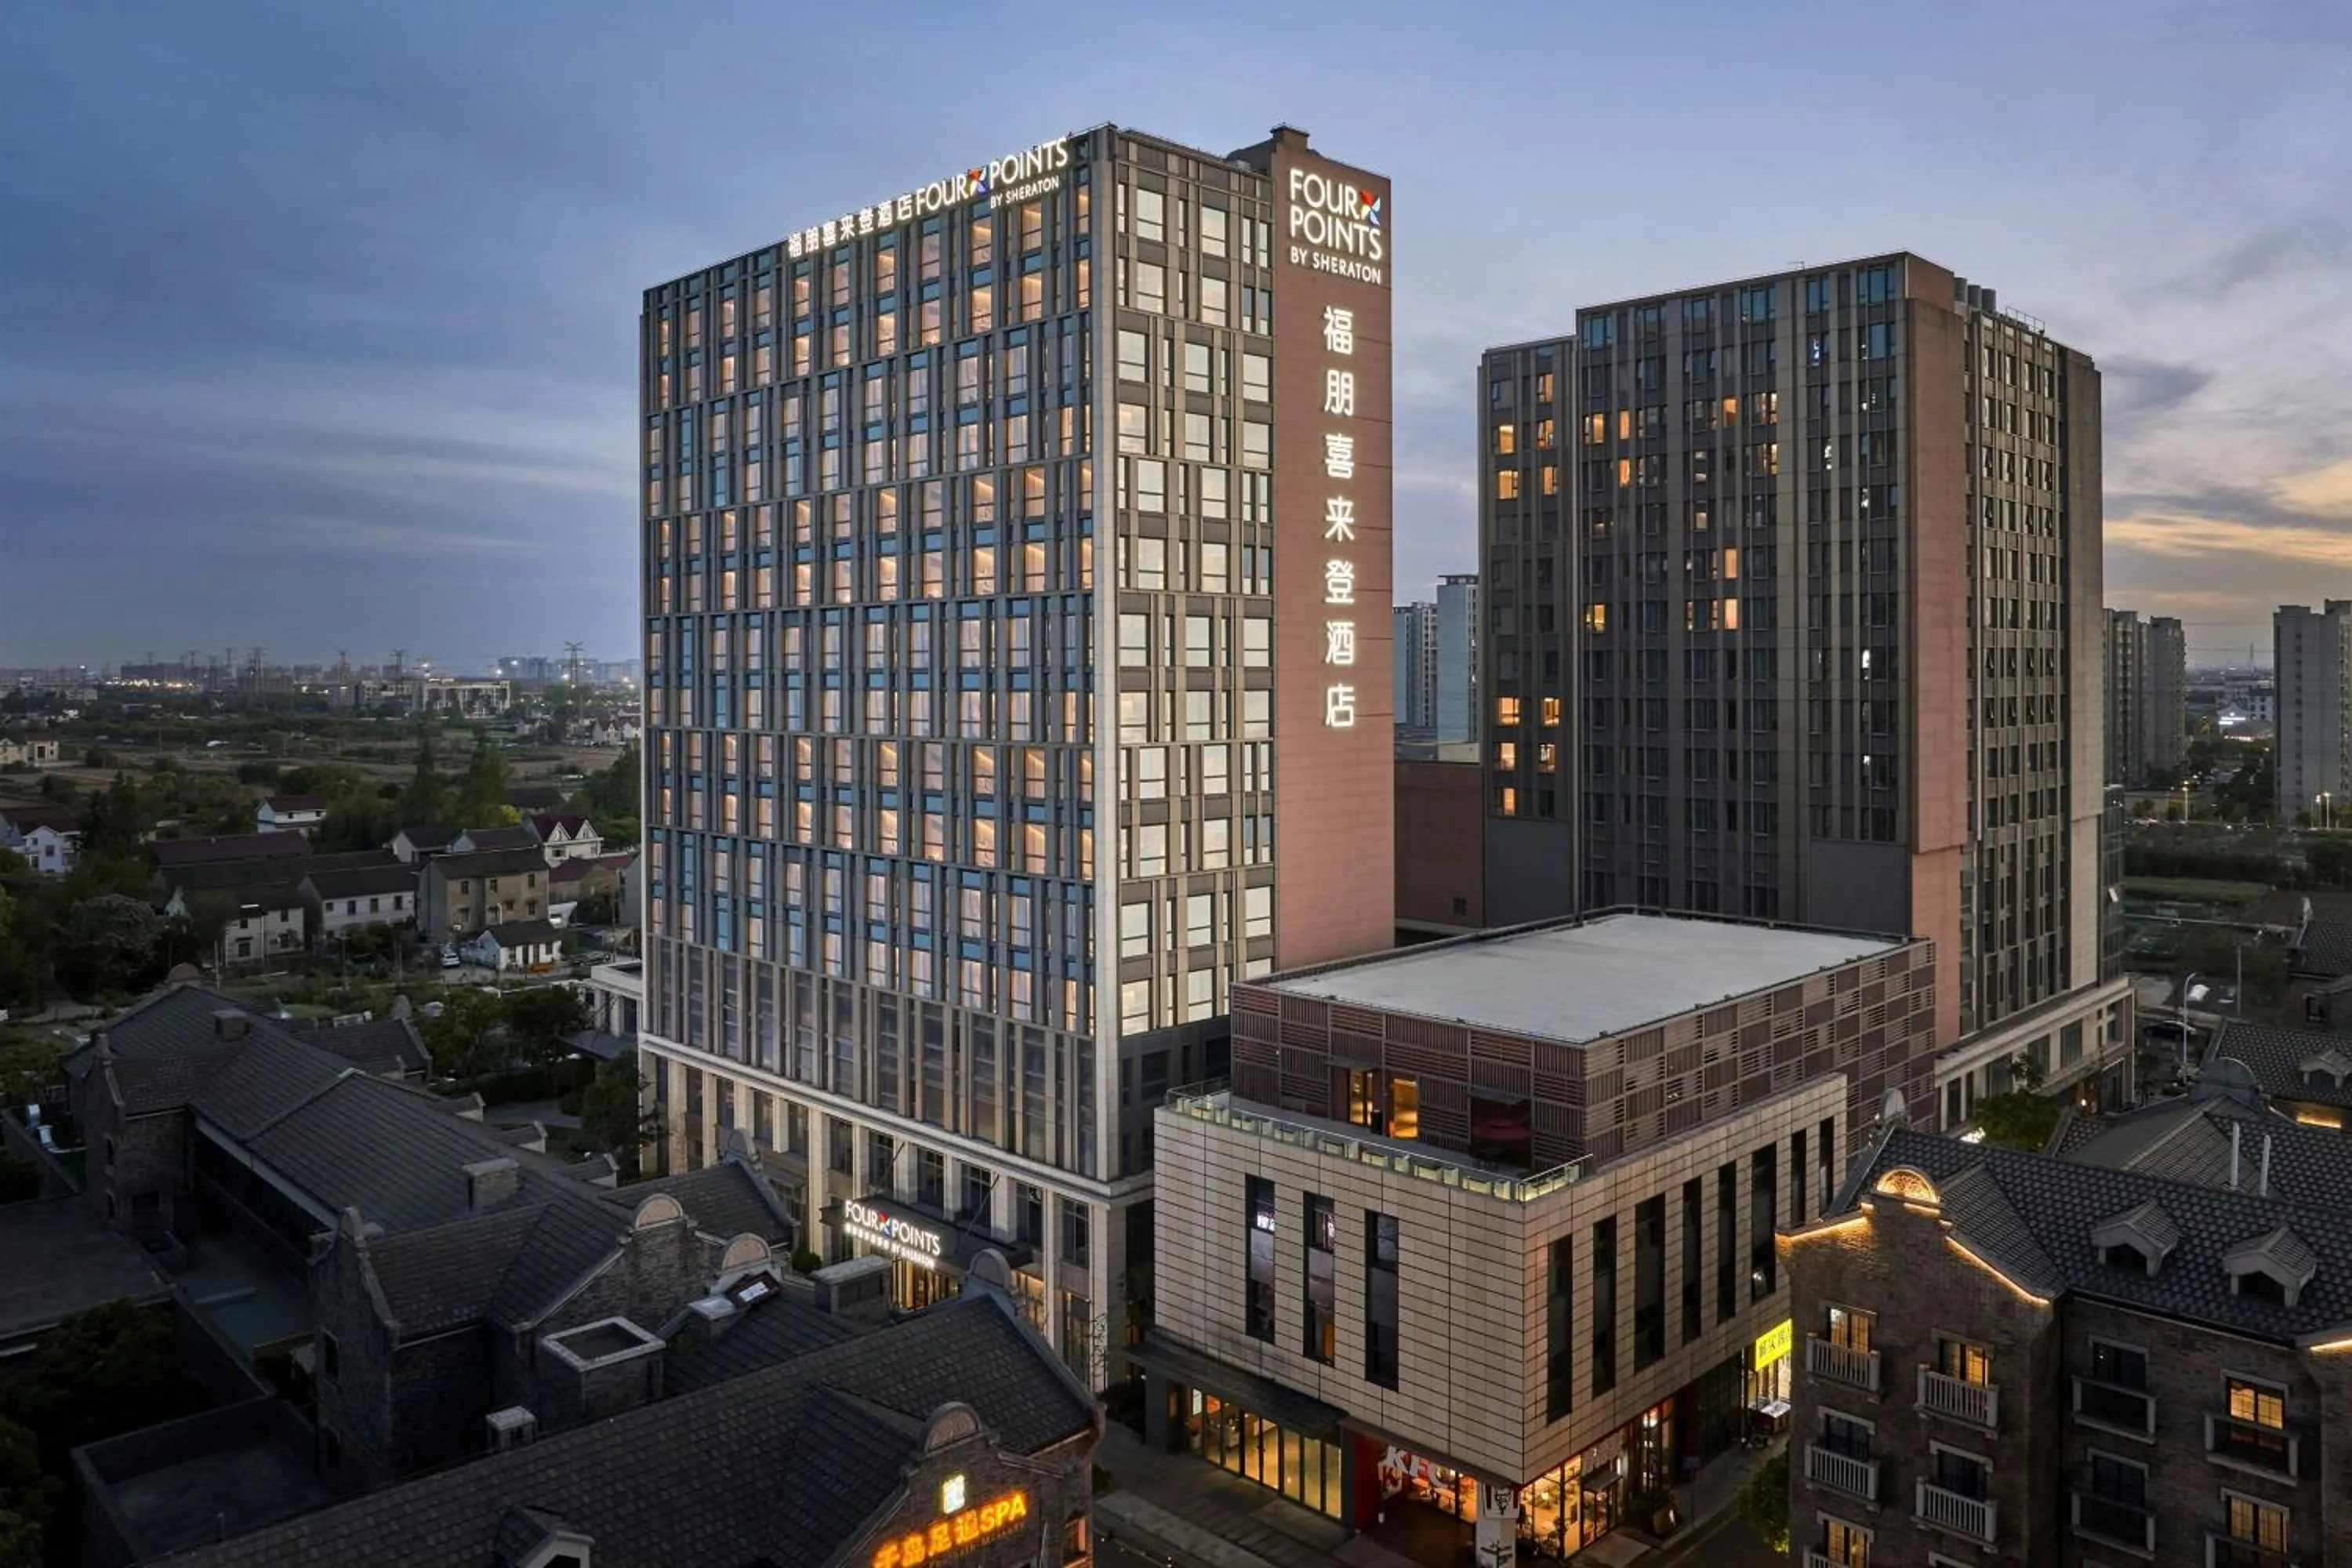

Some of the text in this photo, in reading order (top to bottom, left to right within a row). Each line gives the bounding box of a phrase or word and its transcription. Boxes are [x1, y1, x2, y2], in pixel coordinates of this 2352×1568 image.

[788, 136, 1068, 258] 福朋喜来登酒店 FOUR POINTS
[990, 176, 1059, 209] BY SHERATON
[1290, 168, 1359, 220] FOUR
[1290, 204, 1382, 260] POINTS
[1291, 246, 1381, 285] BY SHERATON
[1323, 305, 1356, 728] 福朋喜来登酒店
[844, 1200, 879, 1232] FOUR
[891, 1218, 942, 1256] POINTS
